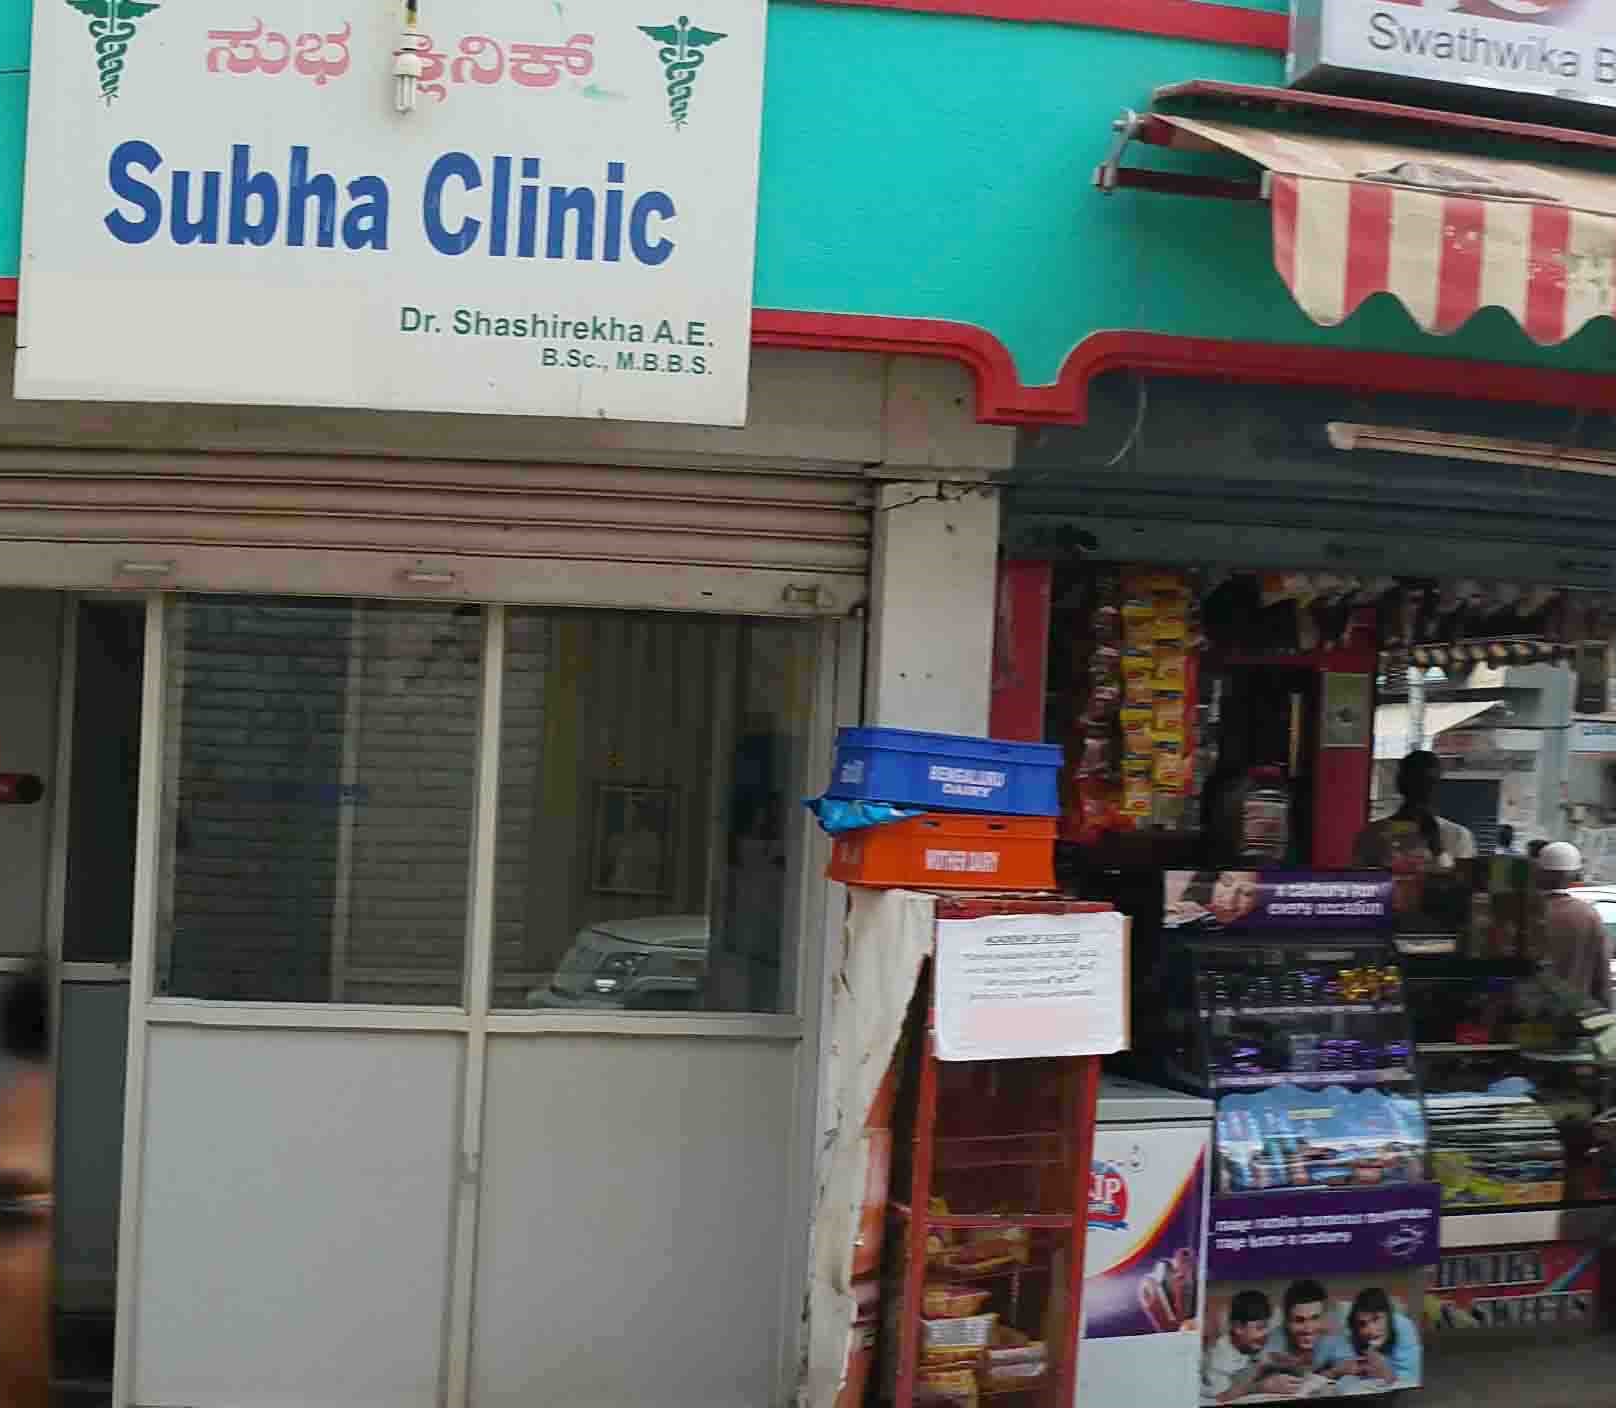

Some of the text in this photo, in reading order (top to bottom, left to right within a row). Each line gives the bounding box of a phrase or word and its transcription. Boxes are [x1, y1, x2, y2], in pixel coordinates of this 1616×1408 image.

[207, 16, 351, 87] ಸುಭ
[1368, 12, 1580, 77] Swathwika
[104, 140, 675, 265] Subha Clinic
[401, 306, 713, 347] Dr. Shashirekha A.E.
[616, 351, 713, 375] M.B.B.S.
